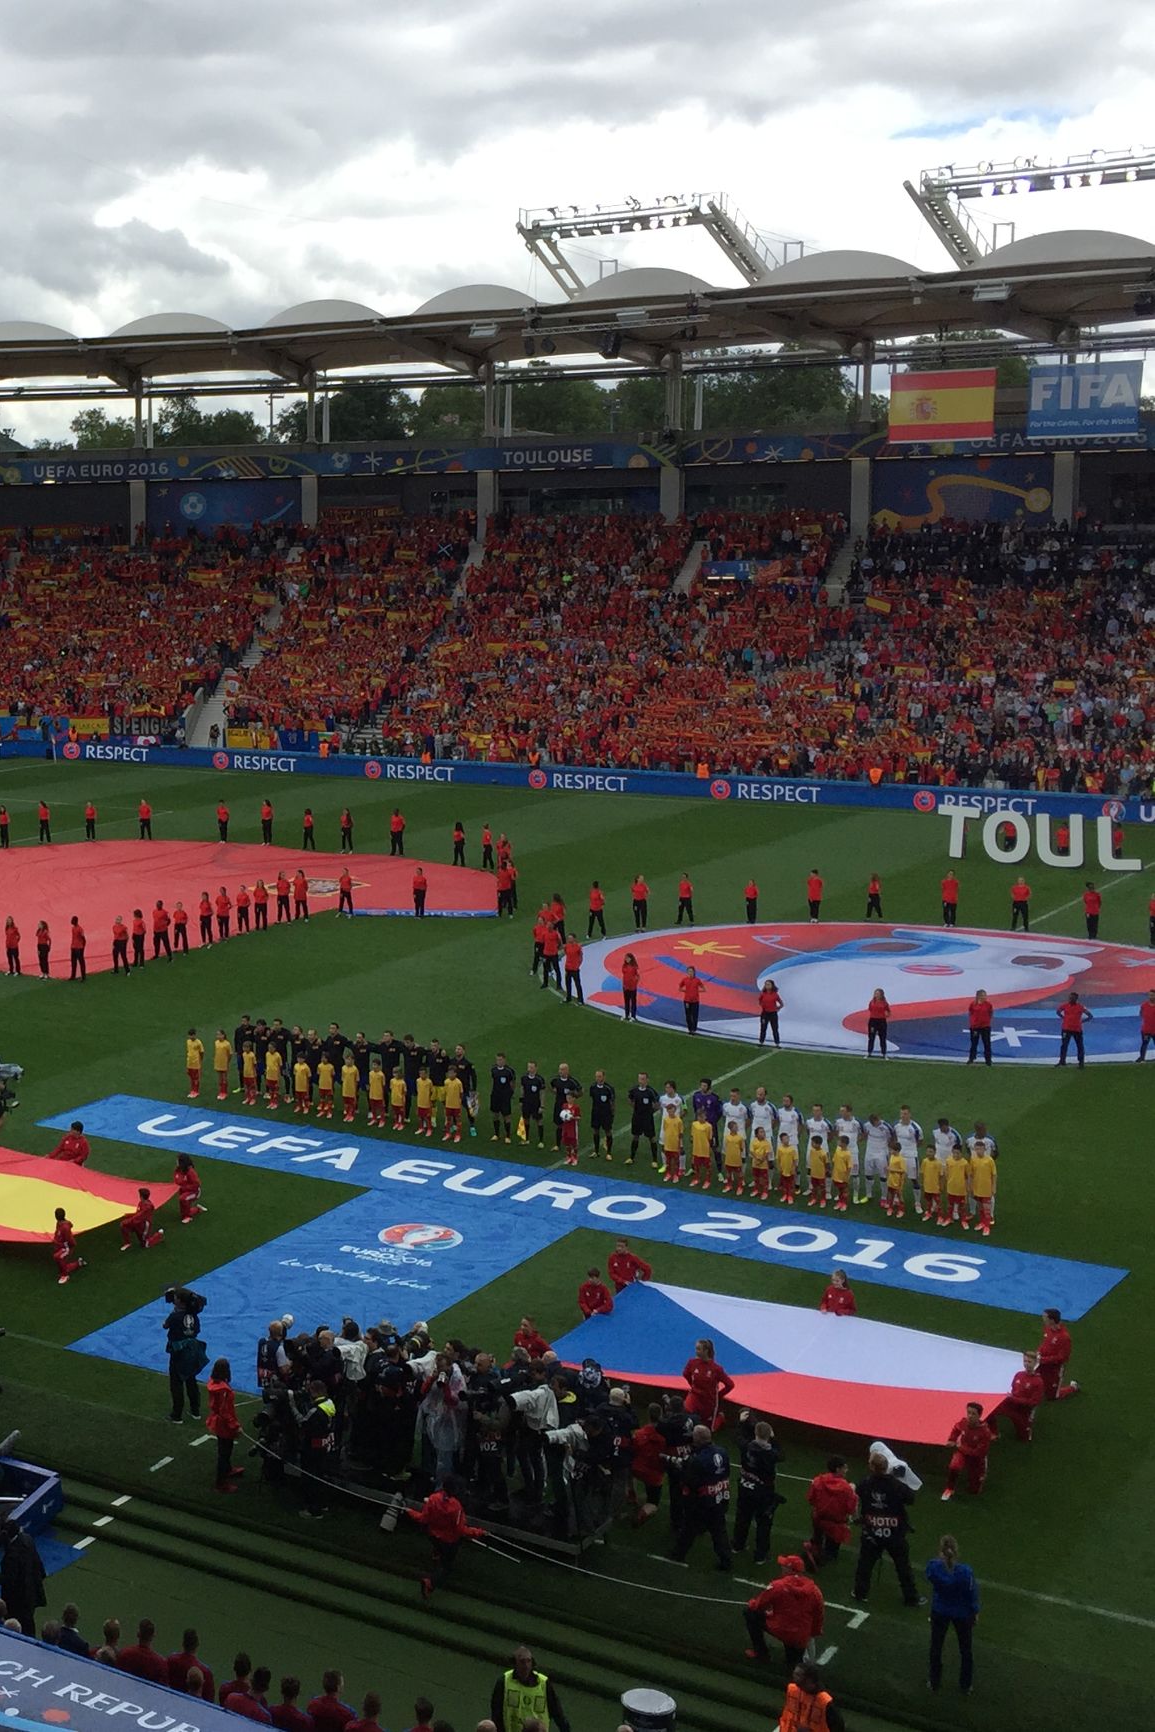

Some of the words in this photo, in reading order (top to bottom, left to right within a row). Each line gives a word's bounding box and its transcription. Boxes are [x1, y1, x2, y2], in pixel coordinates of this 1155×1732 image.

[1031, 374, 1137, 410] FIFA
[503, 448, 593, 465] TOULOUSE
[33, 464, 76, 478] UEFA
[80, 463, 124, 477] EURO
[128, 462, 169, 476] 2016
[86, 744, 149, 763] RESPECT
[234, 755, 296, 773] RESPECT
[387, 764, 454, 783] RESPECT
[553, 773, 627, 792] RESPECT
[738, 783, 821, 803] RESPECT
[938, 804, 1142, 871] TOUL
[137, 1114, 360, 1171] UEFA
[380, 1159, 666, 1221] EURO
[678, 1211, 987, 1283] 2016
